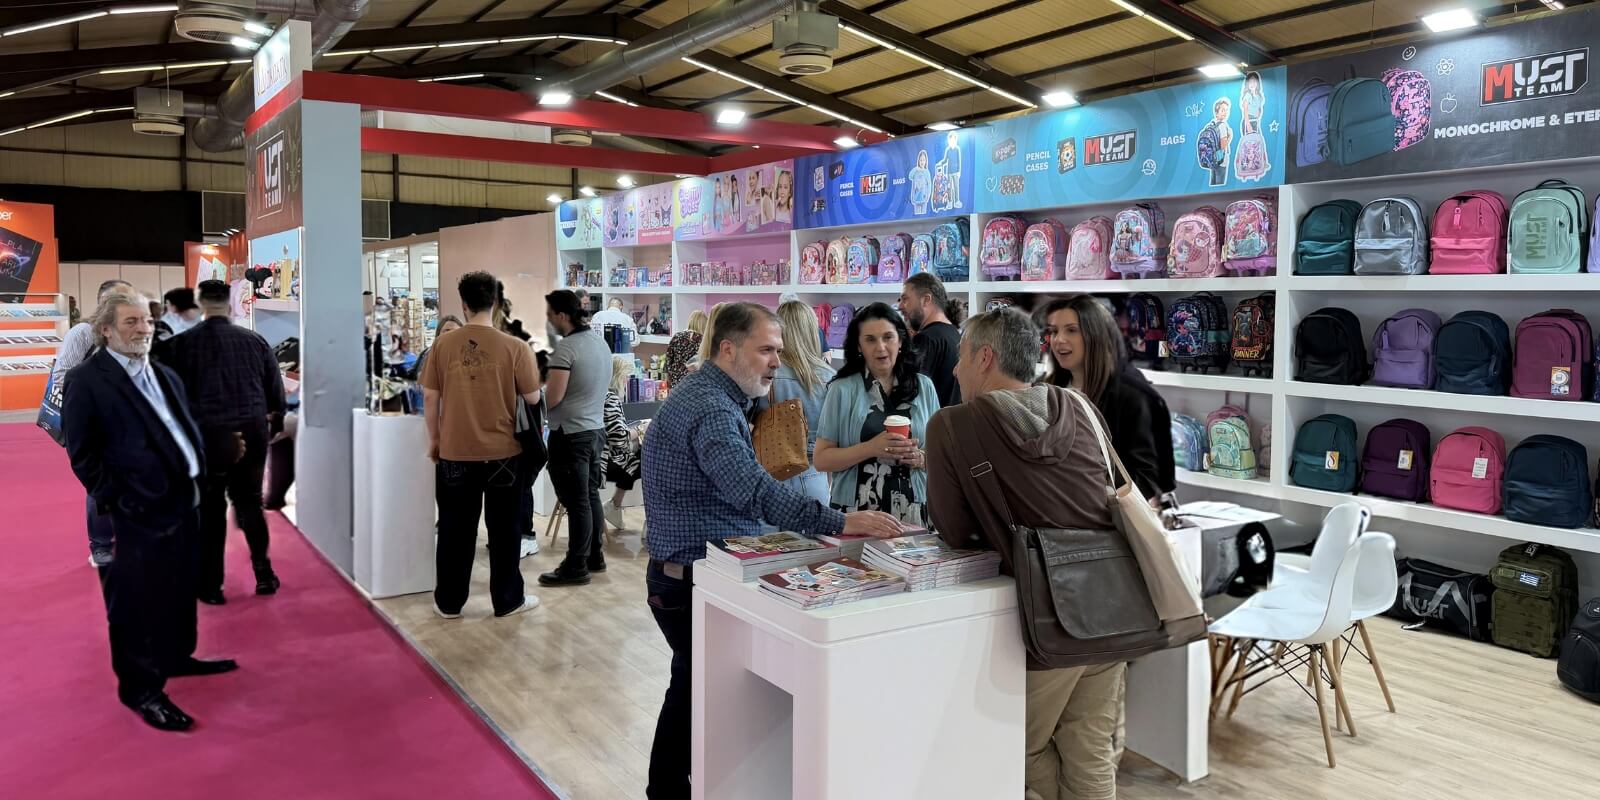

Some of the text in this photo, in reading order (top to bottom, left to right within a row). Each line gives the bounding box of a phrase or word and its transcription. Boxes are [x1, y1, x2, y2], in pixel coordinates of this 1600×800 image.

[1485, 53, 1584, 102] MUST
[1514, 82, 1562, 97] TEAM
[1434, 116, 1545, 139] MONOCHROME
[1549, 114, 1560, 126] &
[1085, 131, 1134, 164] MUST
[1160, 134, 1186, 146] BAGS
[1026, 150, 1051, 161] PENCIL
[1100, 153, 1124, 162] TEAM
[1026, 162, 1048, 172] CASES
[257, 140, 283, 210] MUST
[840, 182, 854, 190] PENCIL
[861, 174, 886, 194] MUST
[1526, 214, 1547, 259] MUST
[8, 240, 22, 251] PLA
